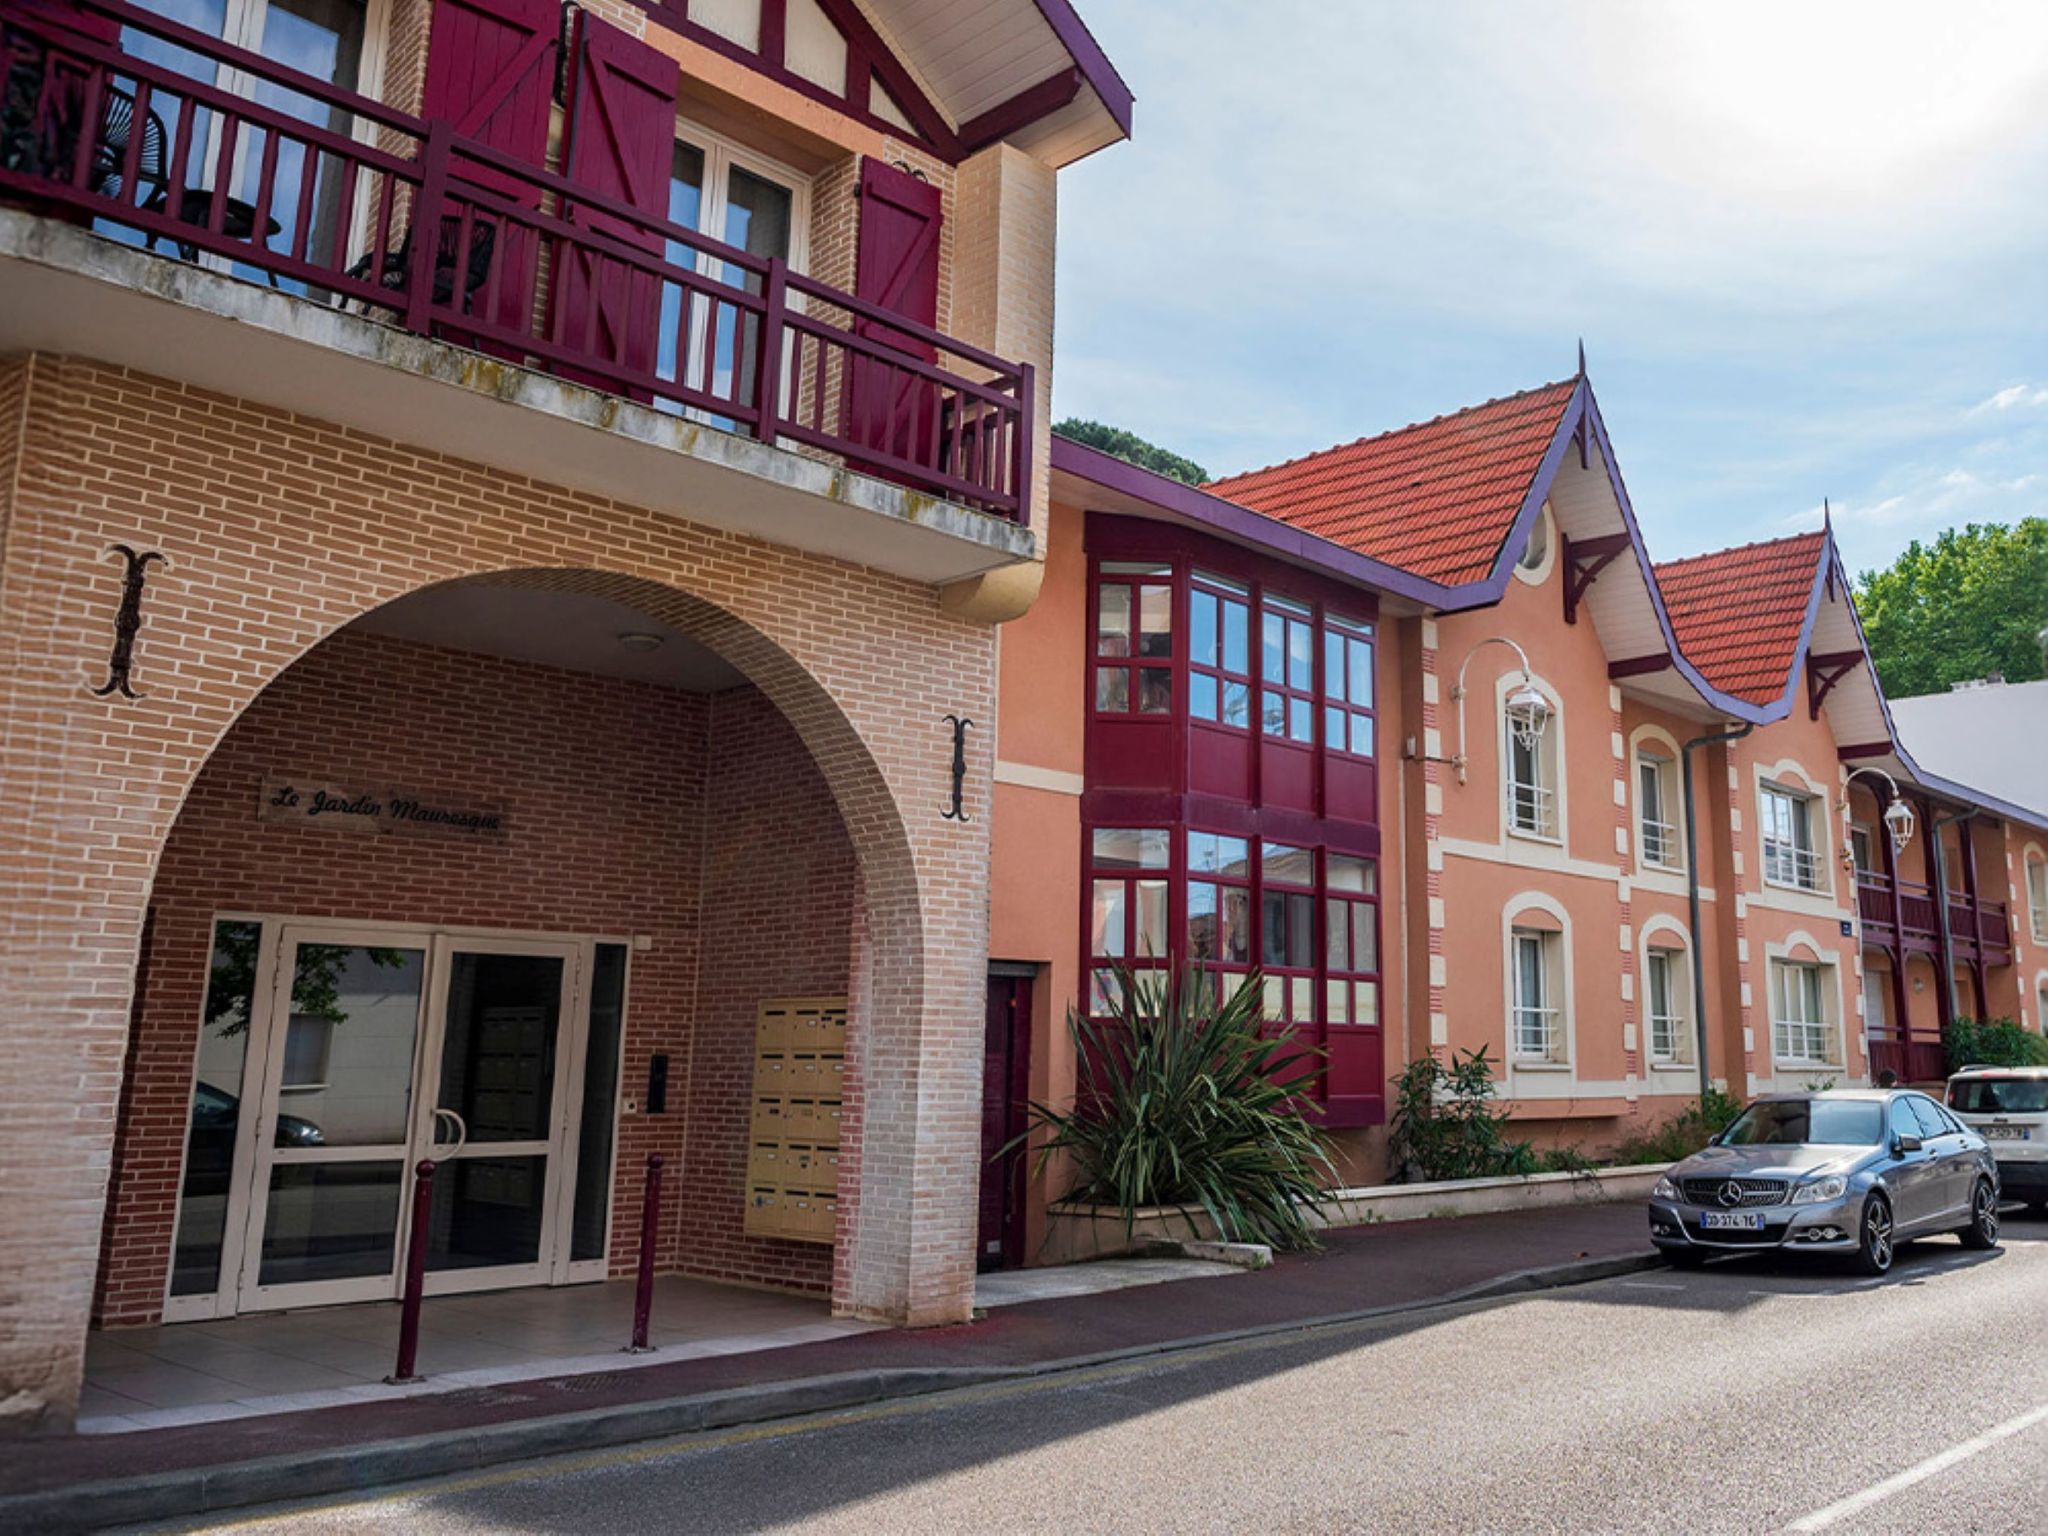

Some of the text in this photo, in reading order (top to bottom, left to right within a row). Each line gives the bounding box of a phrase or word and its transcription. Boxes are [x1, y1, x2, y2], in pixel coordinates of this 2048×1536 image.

[271, 785, 499, 832] Le Jardin Mauresque
